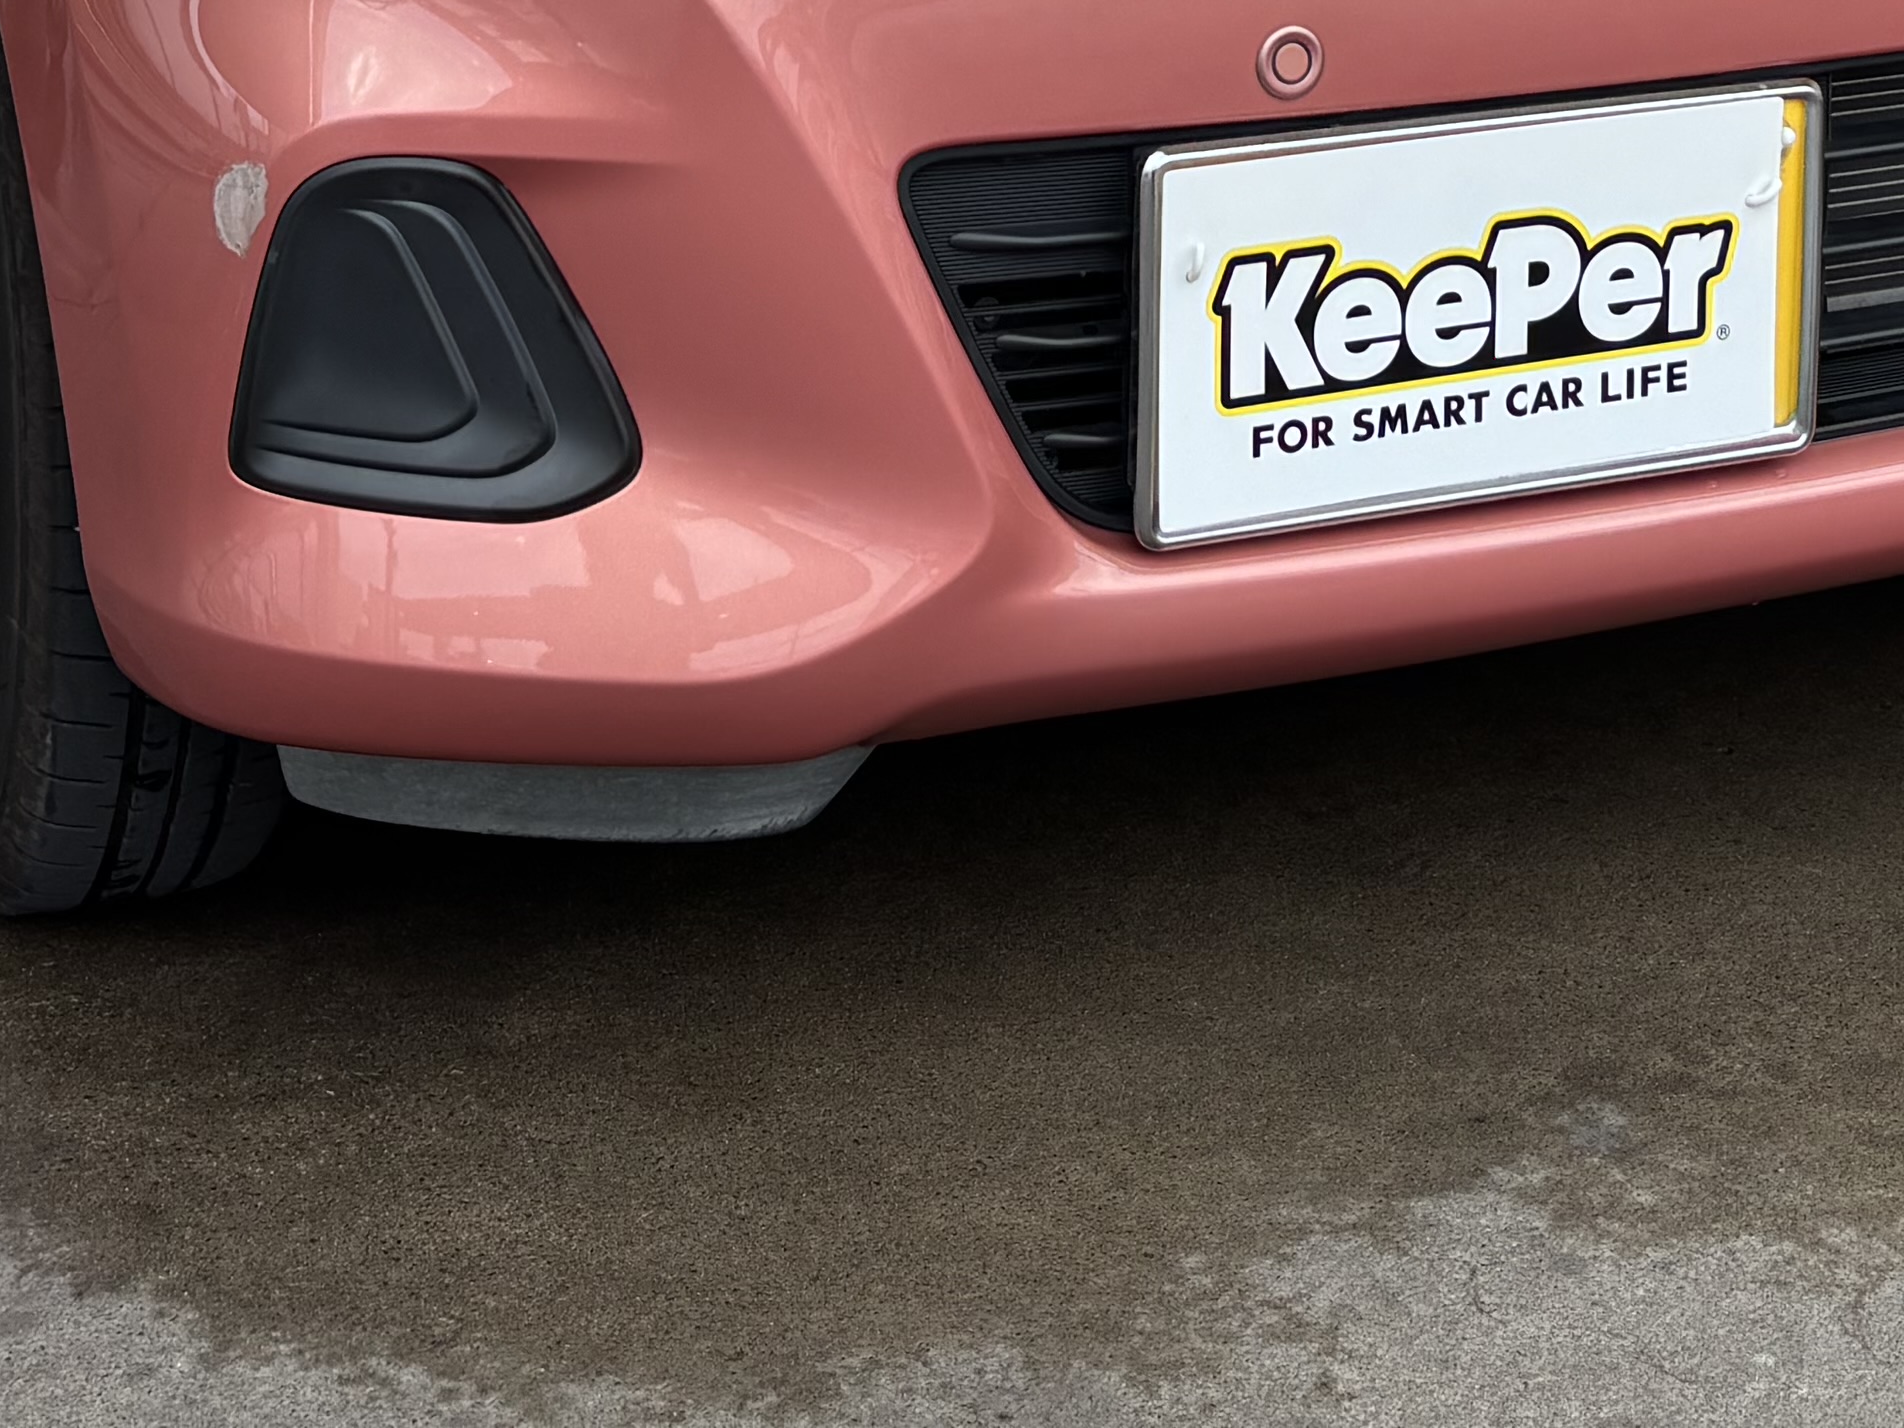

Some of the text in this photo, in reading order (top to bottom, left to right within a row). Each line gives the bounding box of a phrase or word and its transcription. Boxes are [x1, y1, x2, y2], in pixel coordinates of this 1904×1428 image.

[1212, 213, 1736, 410] KeePer
[1251, 359, 1688, 459] FOR SMART CAR LIFE
